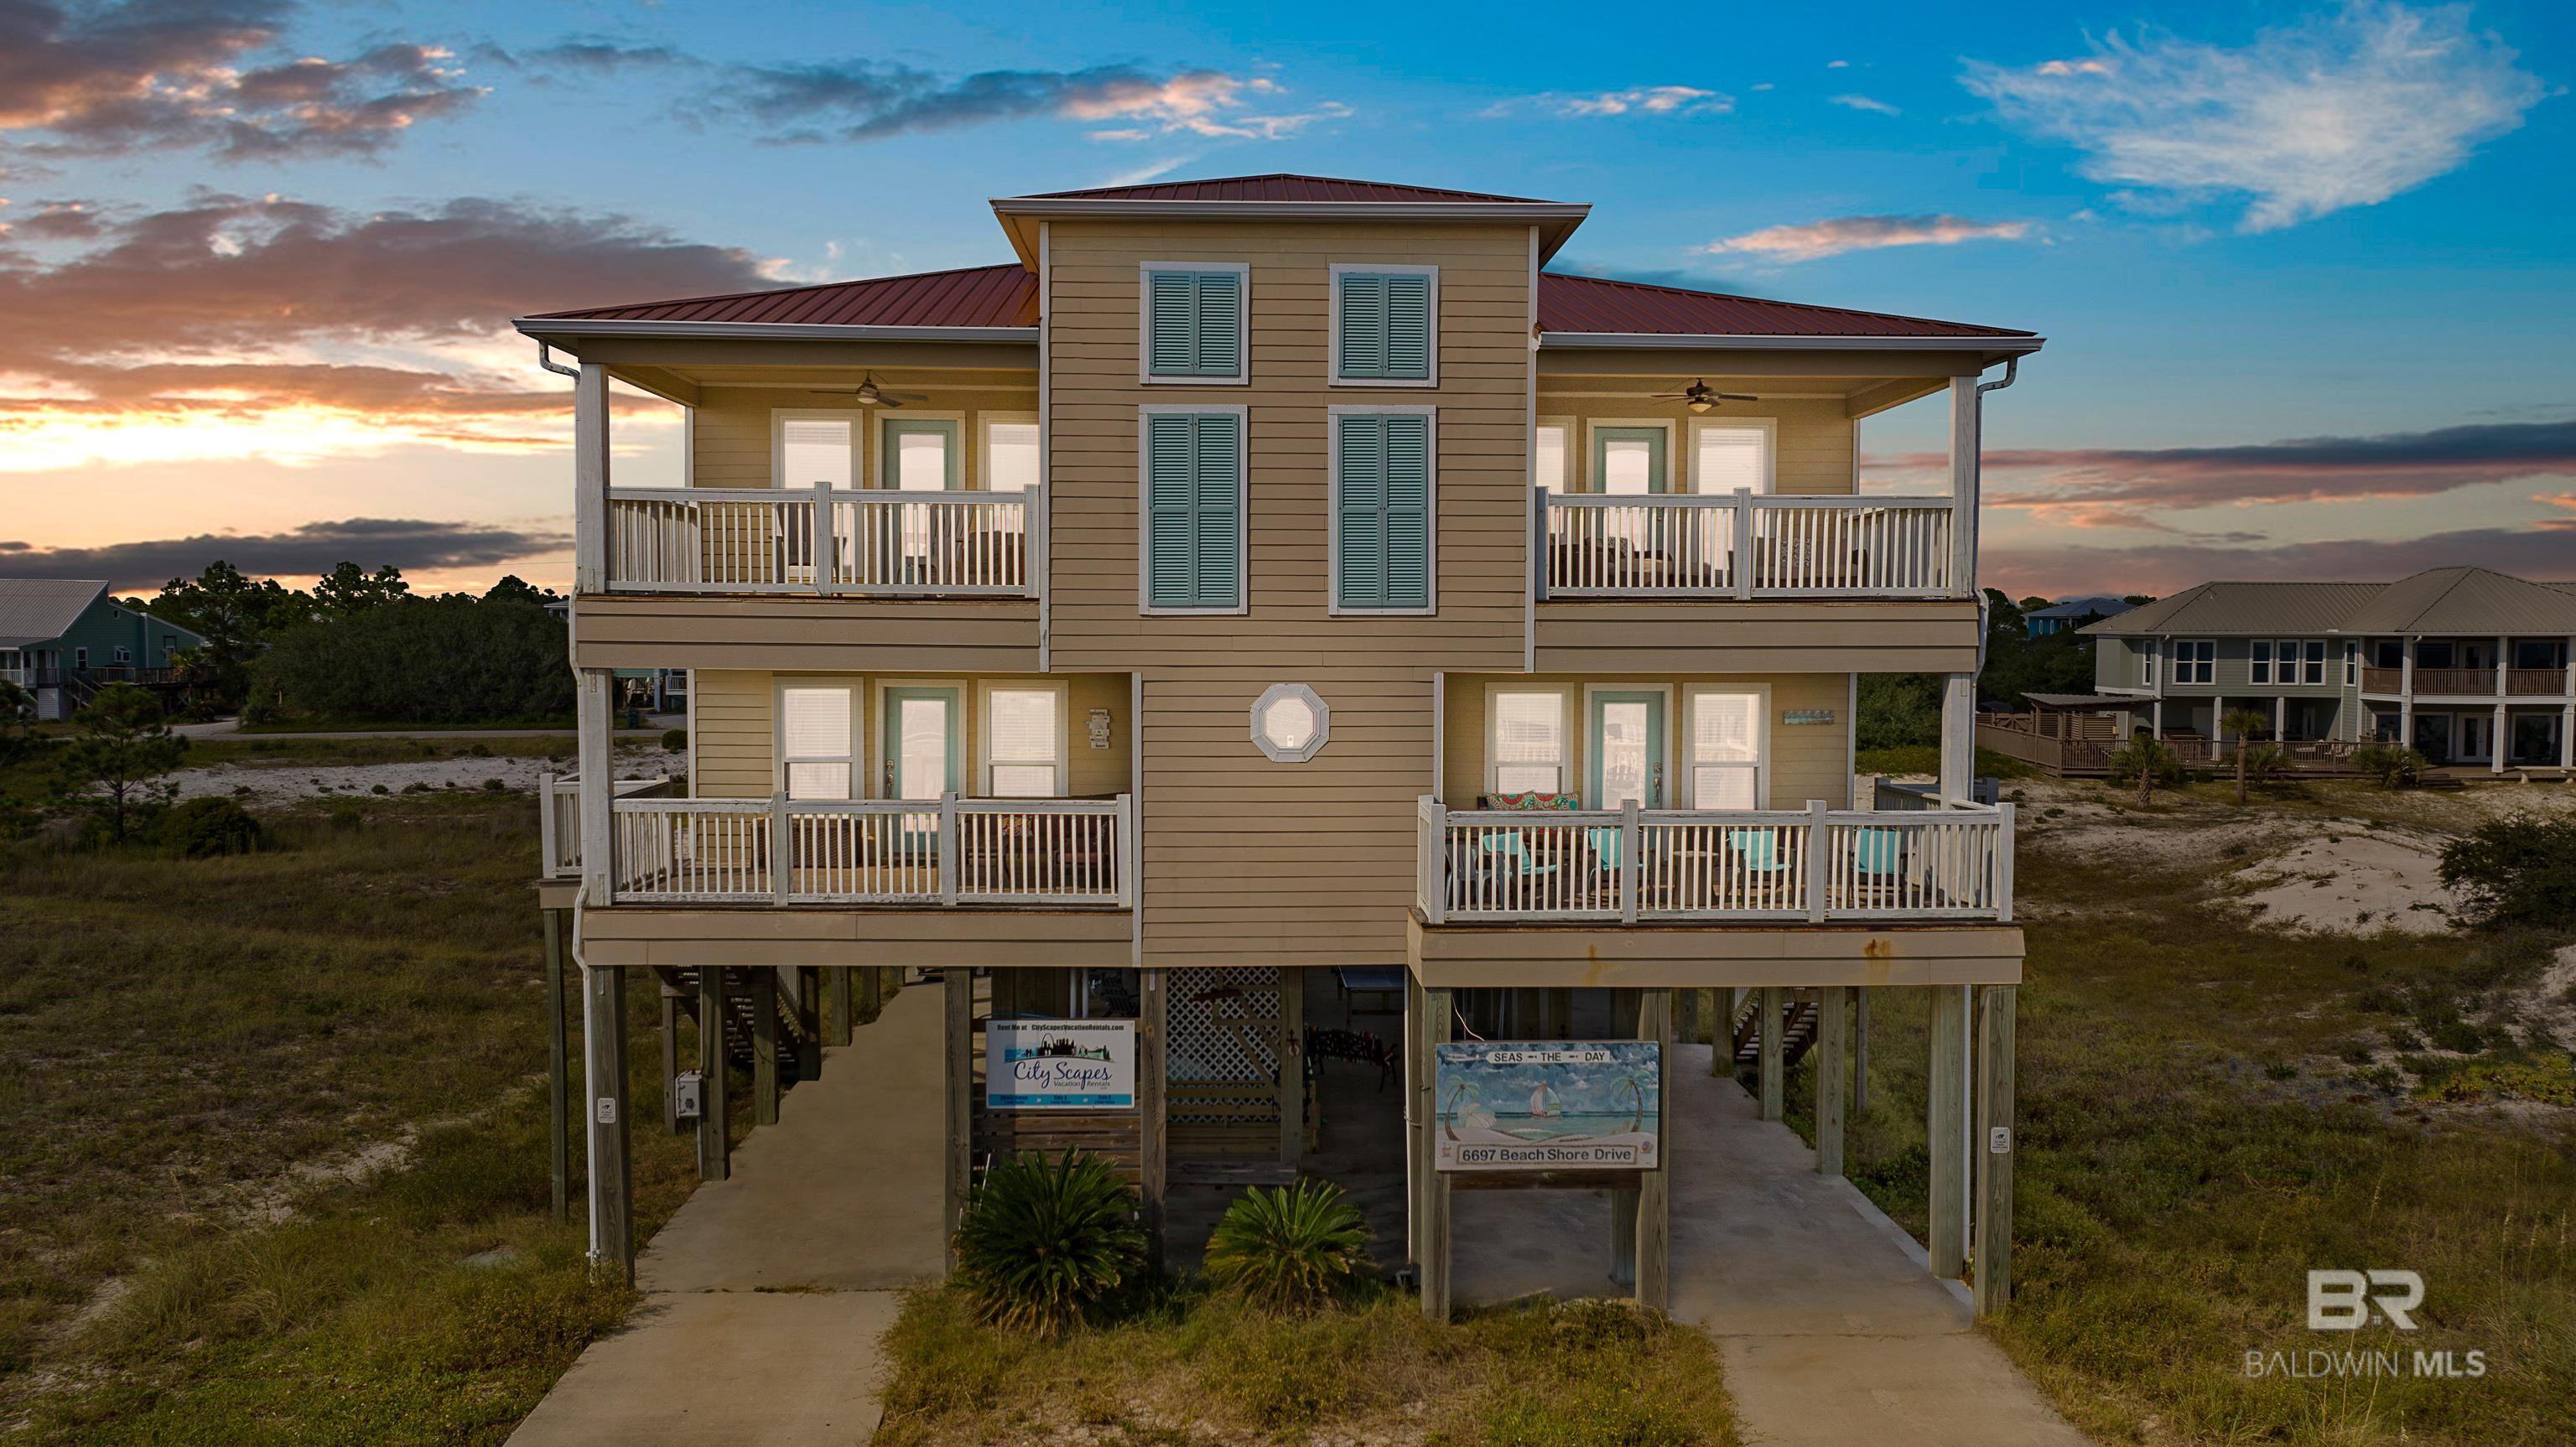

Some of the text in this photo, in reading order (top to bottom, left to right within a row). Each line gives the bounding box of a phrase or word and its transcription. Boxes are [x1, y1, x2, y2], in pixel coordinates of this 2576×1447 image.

[1494, 1052, 1605, 1062] SEAS THE DAY
[1014, 1061, 1113, 1090] City Scapes
[1462, 1148, 1632, 1161] 6697 Beach Shore Drive
